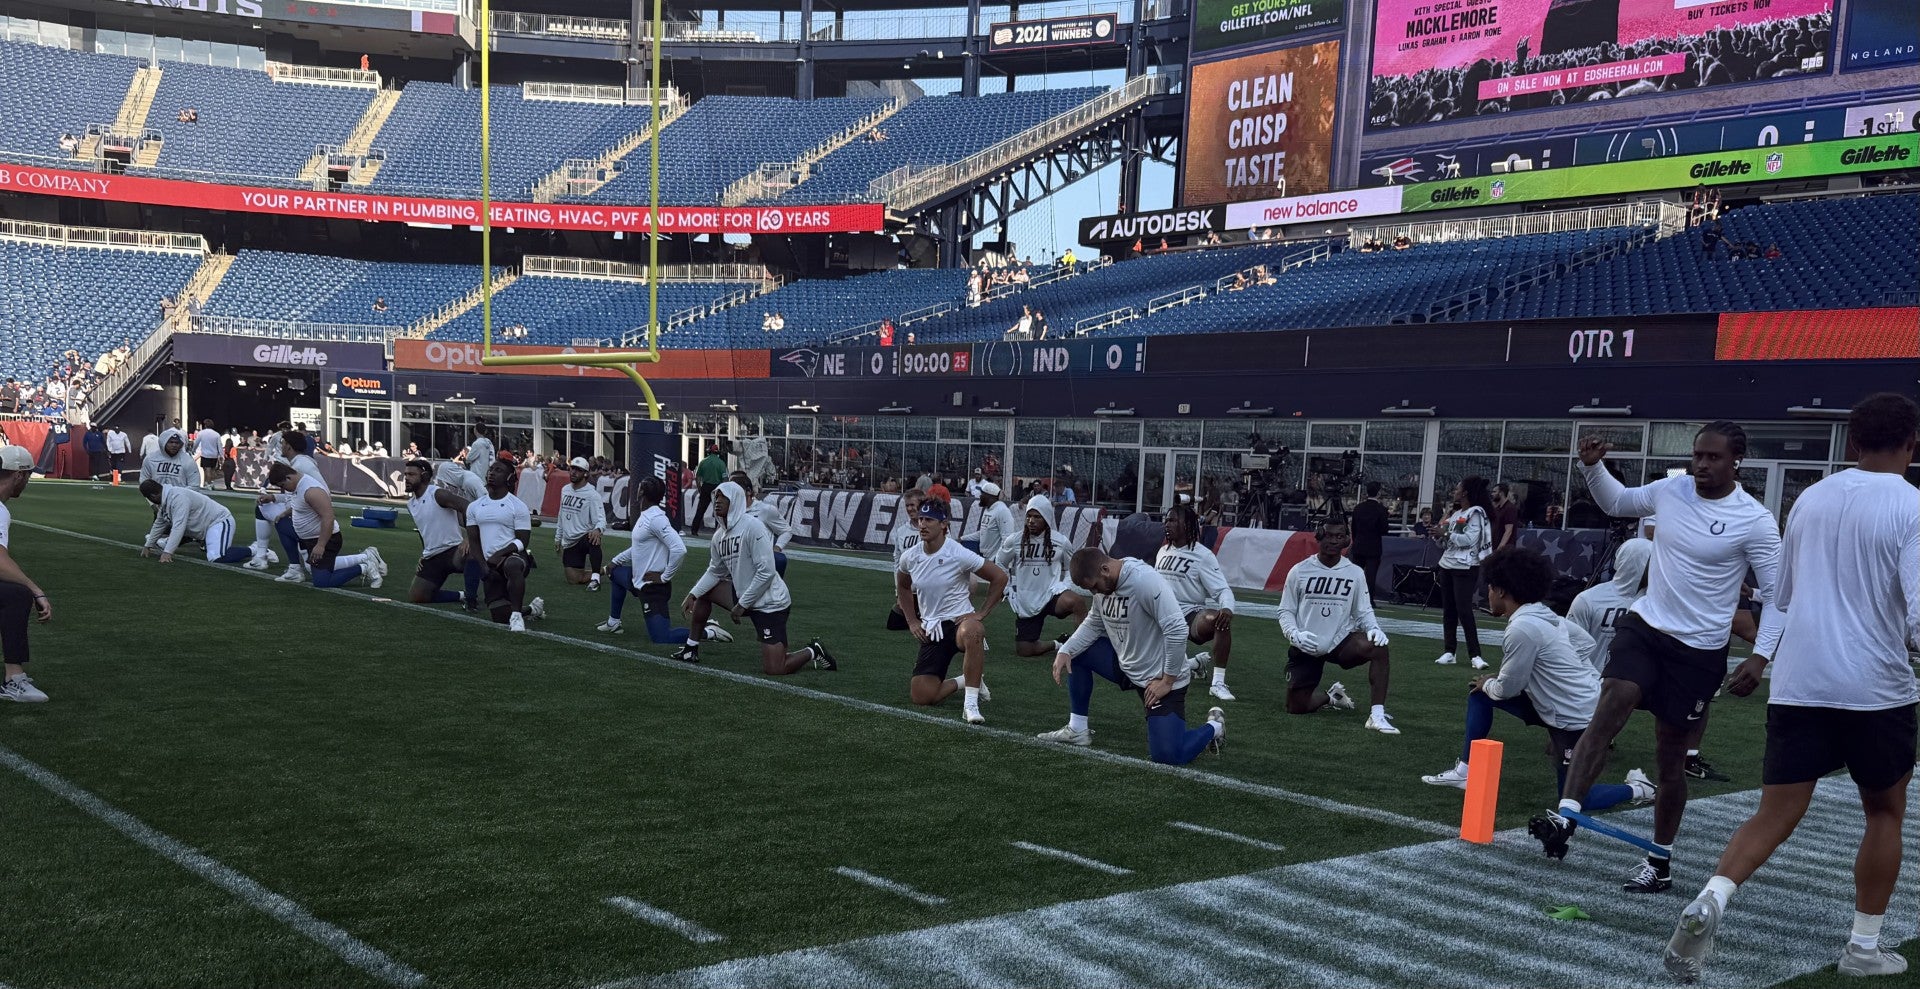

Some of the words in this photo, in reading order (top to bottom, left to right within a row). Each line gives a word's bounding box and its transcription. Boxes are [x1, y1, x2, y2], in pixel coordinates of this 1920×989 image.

[1220, 4, 1313, 32] GILLETTE.COM/NFL
[1231, 5, 1249, 17] GET
[1414, 6, 1430, 16] WITH
[1434, 1, 1462, 13] SPECIAL
[1687, 8, 1704, 20] BUY
[1709, 1, 1748, 17] TICKETS
[1405, 6, 1498, 38] MACKLEMORE
[1015, 25, 1048, 44] 2021
[1051, 28, 1093, 41] WINNERS
[1398, 42, 1419, 52] LUKAS
[1422, 36, 1447, 49] GRAHAM
[1450, 35, 1456, 43] &
[1459, 30, 1481, 41] AARON
[1497, 81, 1509, 94] ON
[1514, 78, 1537, 91] SALE
[1542, 75, 1561, 87] NOW
[1566, 72, 1578, 84] AT
[1584, 60, 1663, 82] EDSHEERAN.COM
[1228, 72, 1294, 112] CLEAN
[1228, 112, 1287, 150] CRISP
[1841, 144, 1911, 166] Gillette
[1225, 152, 1286, 188] TASTE
[1690, 160, 1752, 179] Gillette
[16, 171, 111, 194] COMPANY
[1431, 185, 1480, 203] Gillette
[242, 192, 289, 209] YOUR
[294, 196, 368, 214] PARTNER
[373, 201, 388, 215] IN
[393, 203, 479, 223] PLUMBING,
[559, 210, 608, 228] HVAC,
[612, 212, 639, 226] PVF
[642, 212, 675, 227] AND
[678, 212, 719, 227] MORE
[724, 212, 752, 227] FOR
[786, 211, 830, 227] YEARS
[1264, 205, 1291, 221] new
[1296, 197, 1358, 218] balance
[1110, 209, 1214, 239] AUTODESK
[253, 344, 328, 366] Gillette
[1568, 330, 1614, 363] QTR
[1622, 329, 1634, 357] 1
[823, 353, 845, 376] NE
[871, 352, 884, 375] 0
[904, 352, 950, 374] 90:00
[954, 355, 967, 369] 25
[1032, 347, 1069, 373] IND
[1106, 344, 1122, 370] 0
[342, 376, 381, 390] Optum
[54, 424, 67, 434] 84
[157, 462, 181, 475] COLTS
[562, 494, 586, 509] COLTS
[1158, 555, 1194, 574] COLTS
[1305, 576, 1354, 597] COLTS
[1101, 595, 1129, 618] COLTS
